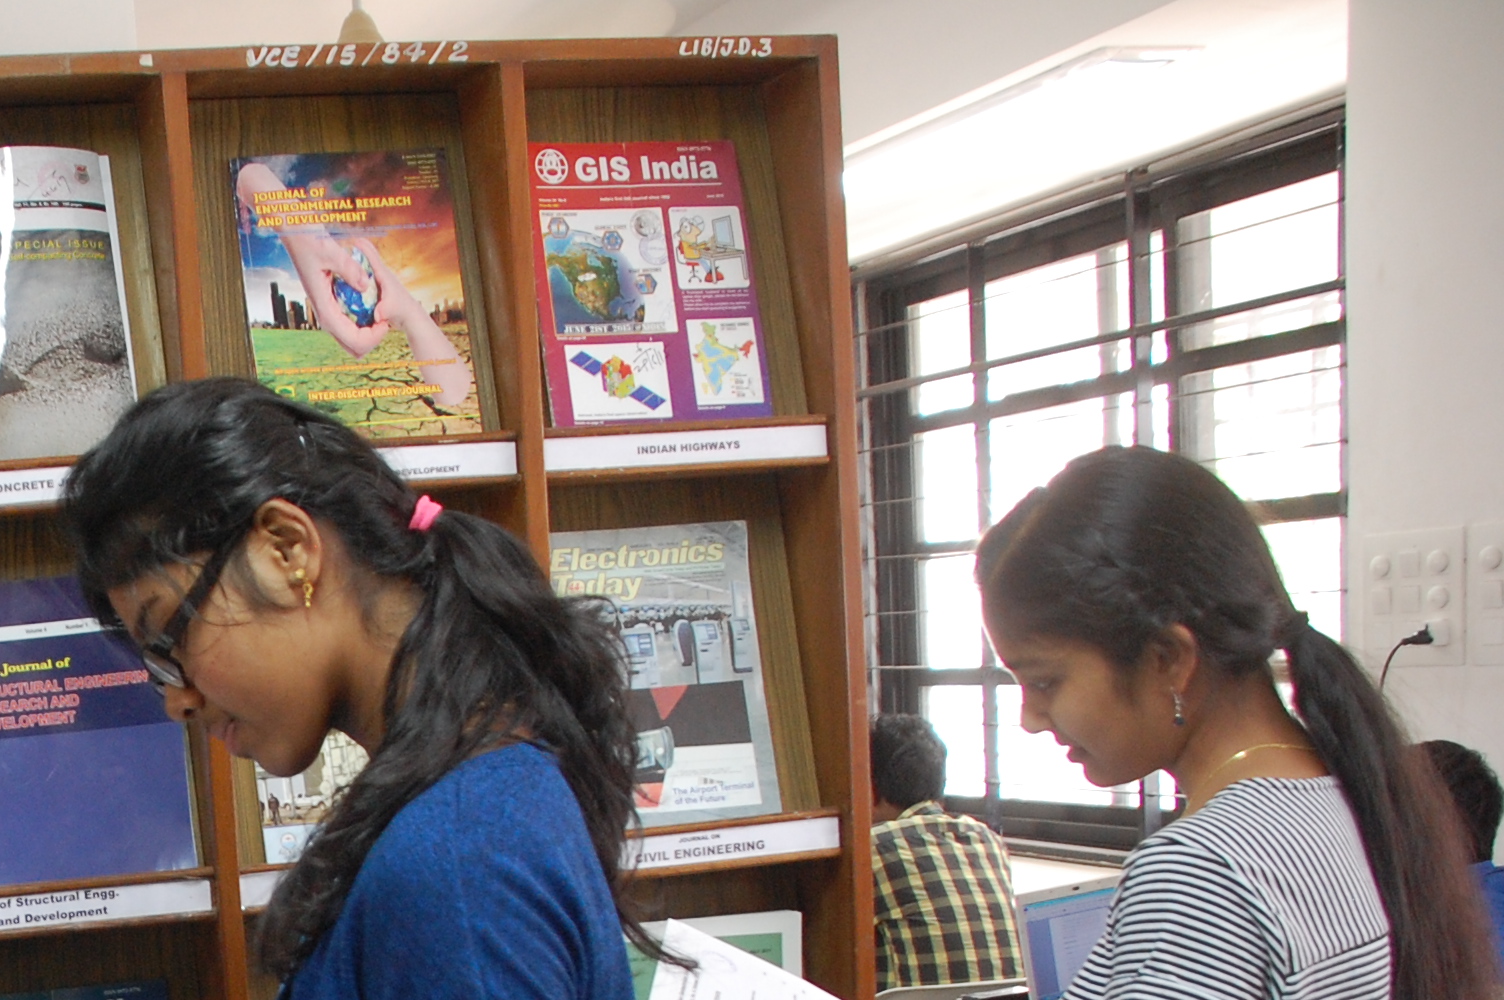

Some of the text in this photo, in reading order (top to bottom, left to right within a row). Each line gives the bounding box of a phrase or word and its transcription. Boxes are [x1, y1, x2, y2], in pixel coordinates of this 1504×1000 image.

[575, 155, 718, 182] GIS India
[254, 187, 325, 203] JOURNAL OF
[256, 196, 411, 215] ENVIRONMENTAL RESEARCH
[258, 212, 367, 227] AND DEVELOPMENT
[68, 240, 104, 249] ISSUE
[564, 324, 585, 334] JUNE
[401, 384, 443, 395] JOURNAL
[637, 440, 740, 455] INDIAN HIGHWAYS
[551, 540, 725, 572] Electronics
[553, 573, 642, 601] Today
[0, 659, 53, 677] Journal
[56, 657, 70, 669] of
[50, 693, 80, 709] AND
[673, 782, 755, 795] The Airport Terminal
[679, 835, 709, 843] JOURNAL
[635, 840, 765, 863] CIVIL ENGINEERING
[0, 899, 11, 909] of
[16, 892, 79, 907] Structural
[84, 889, 119, 900] Engg.
[25, 906, 108, 924] Development
